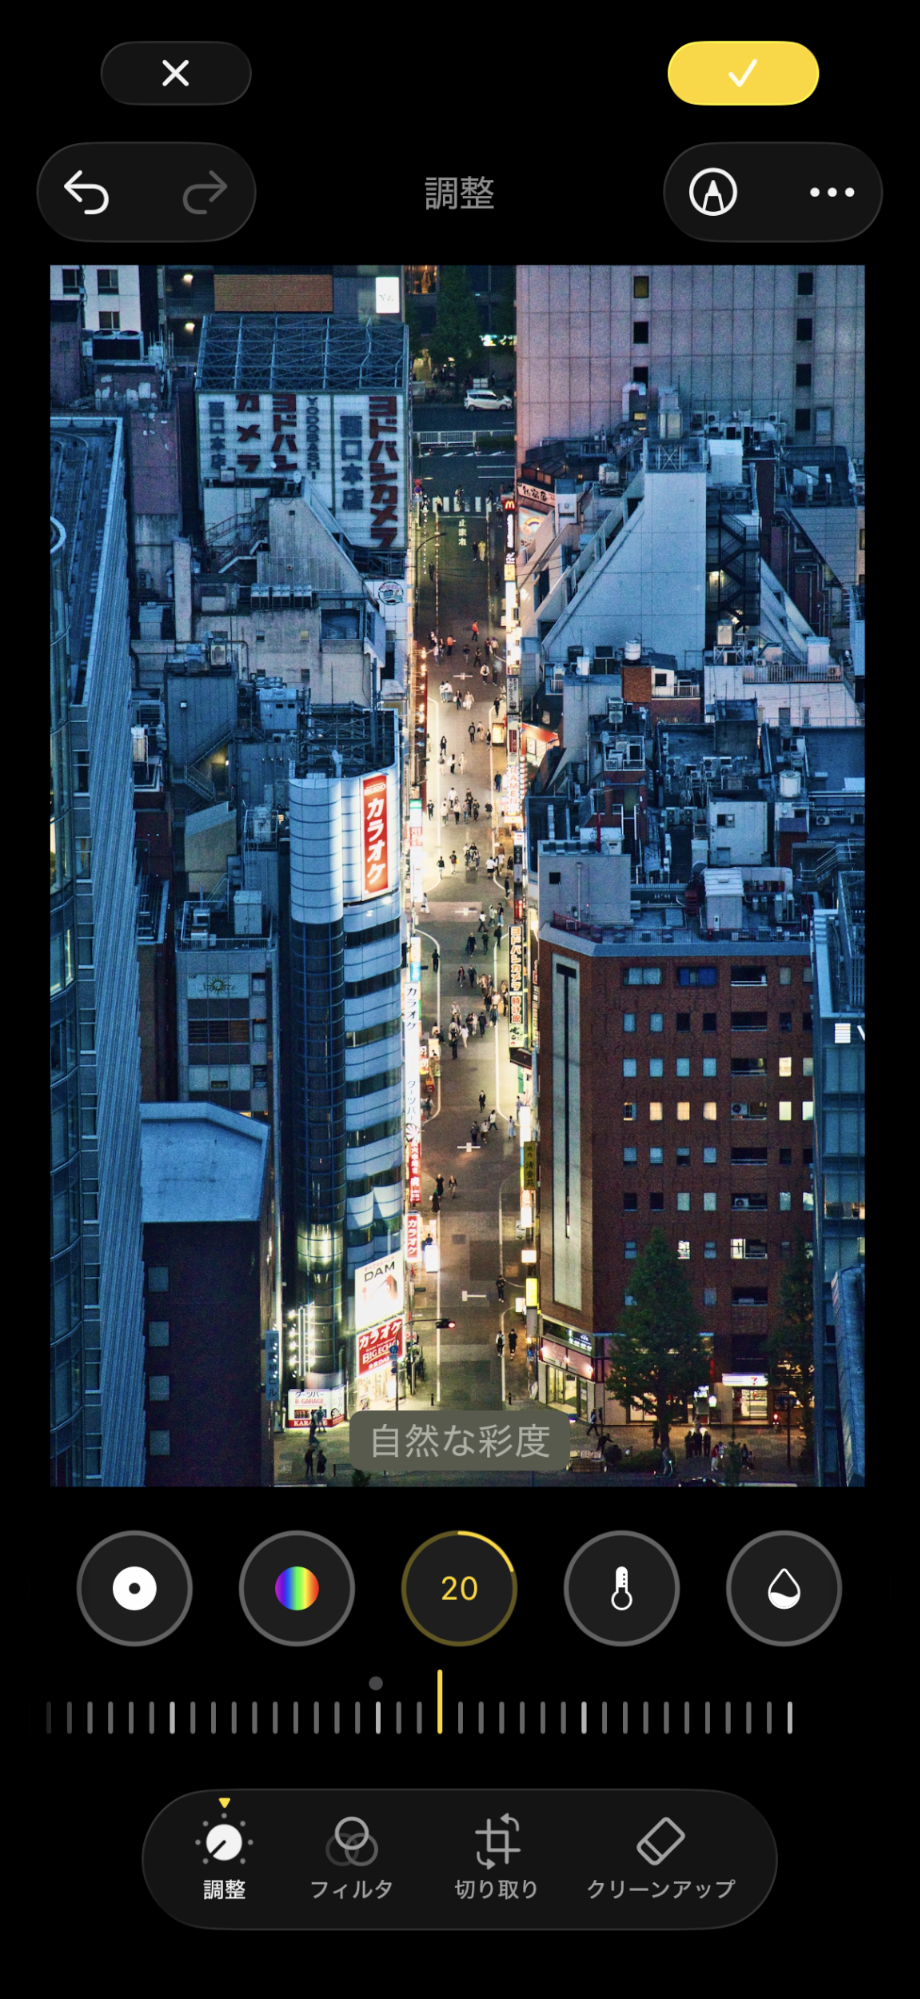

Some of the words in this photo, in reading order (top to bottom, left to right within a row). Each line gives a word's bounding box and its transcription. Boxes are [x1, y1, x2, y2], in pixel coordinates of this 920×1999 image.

[209, 401, 225, 469] 西口本店
[236, 394, 260, 472] カメラ
[271, 394, 297, 471] ヨドバシ
[306, 397, 320, 480] YODOBASHI
[340, 415, 363, 510] 西口本店
[369, 396, 399, 547] ヨドバシカメラ
[458, 519, 467, 546] 止まれ
[510, 767, 518, 804] RAMEN
[366, 798, 386, 885] カラオケ
[510, 926, 522, 991] ヨドバシカメラ
[406, 987, 417, 1030] カラオケ
[511, 996, 522, 1023] 時計館
[408, 1219, 417, 1255] カラオケ
[364, 1261, 395, 1282] DAM
[359, 1321, 402, 1350] カラオケ
[363, 1349, 377, 1364] BIG
